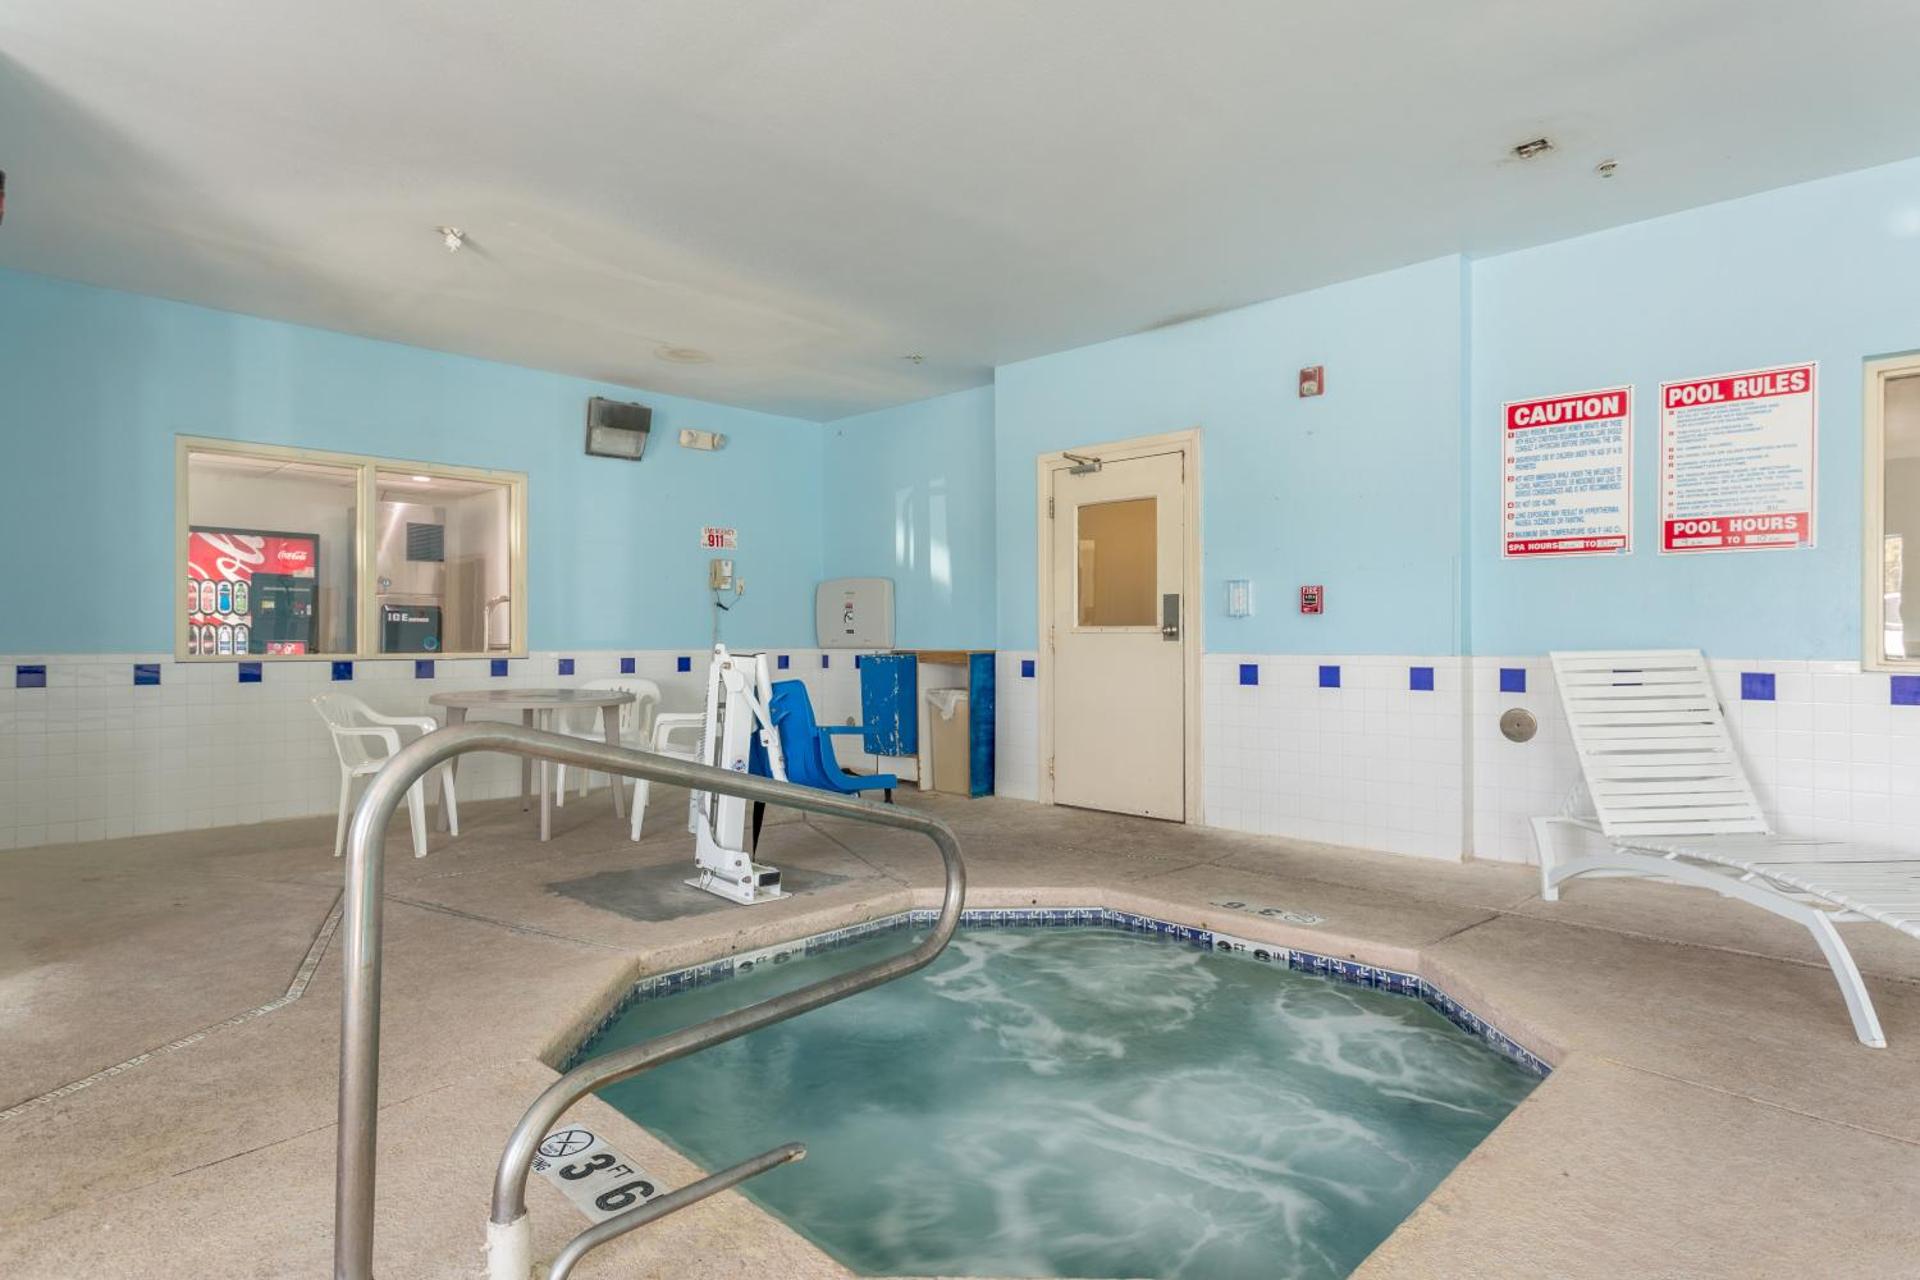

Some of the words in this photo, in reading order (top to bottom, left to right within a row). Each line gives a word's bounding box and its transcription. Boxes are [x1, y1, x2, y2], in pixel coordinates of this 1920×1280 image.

[1668, 383, 1725, 407] POOL
[1732, 371, 1806, 398] RULES
[1514, 396, 1619, 426] CAUTION
[1673, 521, 1722, 535] POOL
[1729, 516, 1798, 532] HOURS
[708, 534, 724, 547] 911
[1508, 543, 1525, 551] SPA
[1726, 536, 1740, 545] TO
[387, 612, 408, 622] ICE
[559, 1153, 616, 1181] 3
[606, 1164, 635, 1179] FT
[595, 1180, 655, 1212] 6
